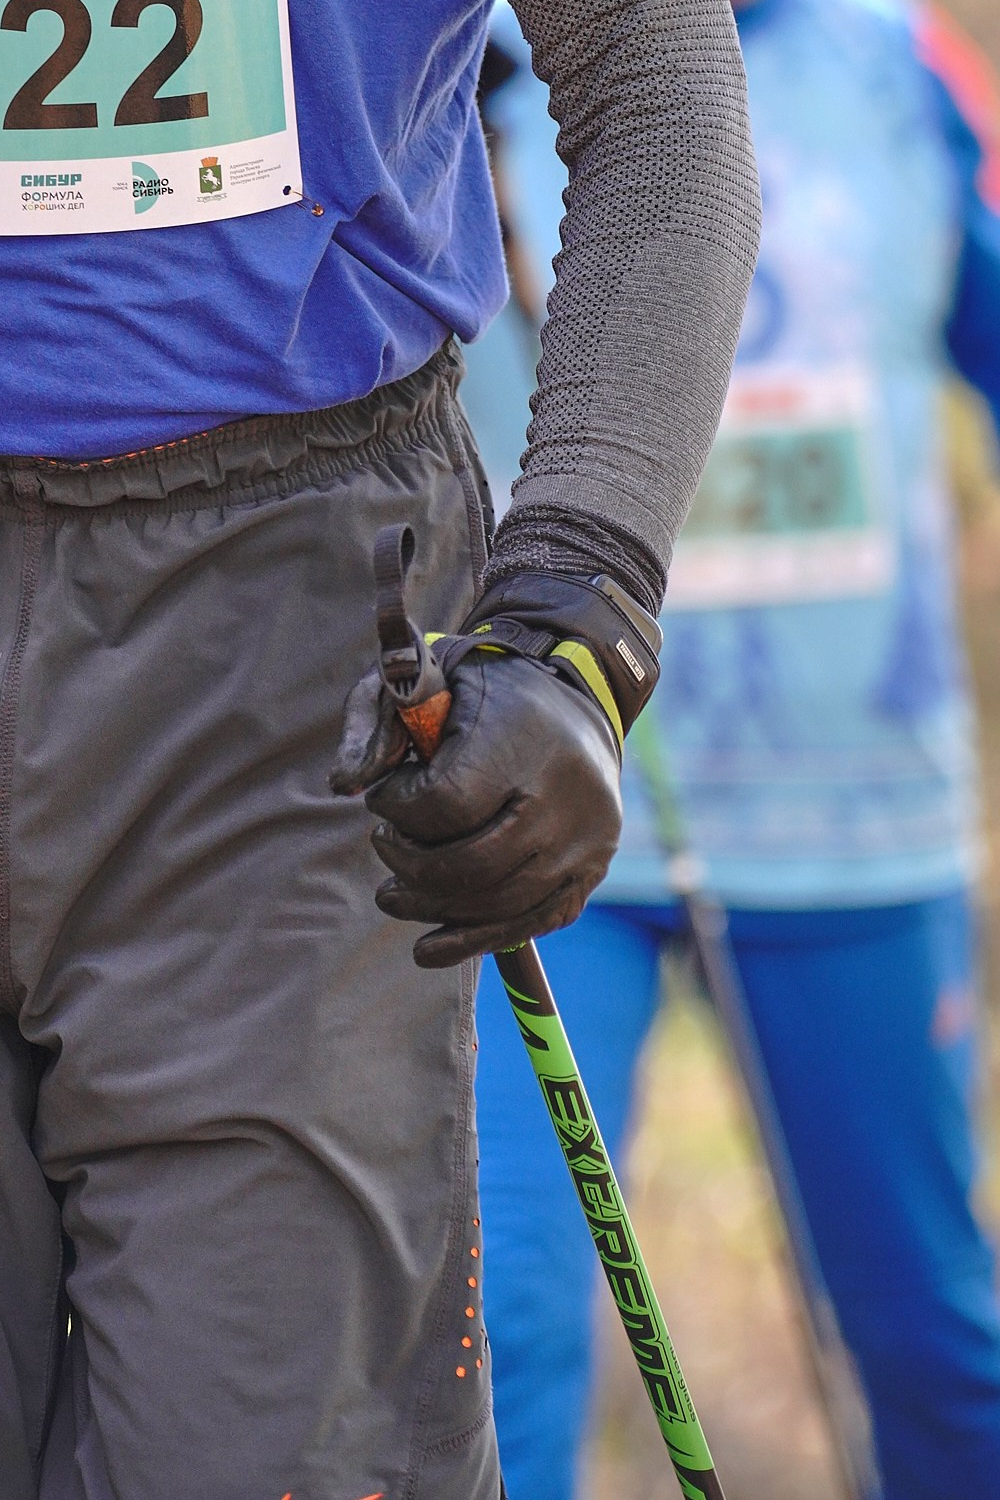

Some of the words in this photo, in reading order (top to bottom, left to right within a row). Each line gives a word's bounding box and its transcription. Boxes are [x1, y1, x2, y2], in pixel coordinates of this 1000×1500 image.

[21, 174, 82, 187] СИБУР
[132, 178, 169, 189] РАДИО
[21, 191, 83, 202] ФОРМУЛА
[132, 187, 174, 198] СИБИРЬ
[22, 202, 66, 211] ХОРОШИХ
[67, 202, 85, 211] ДЕЛ
